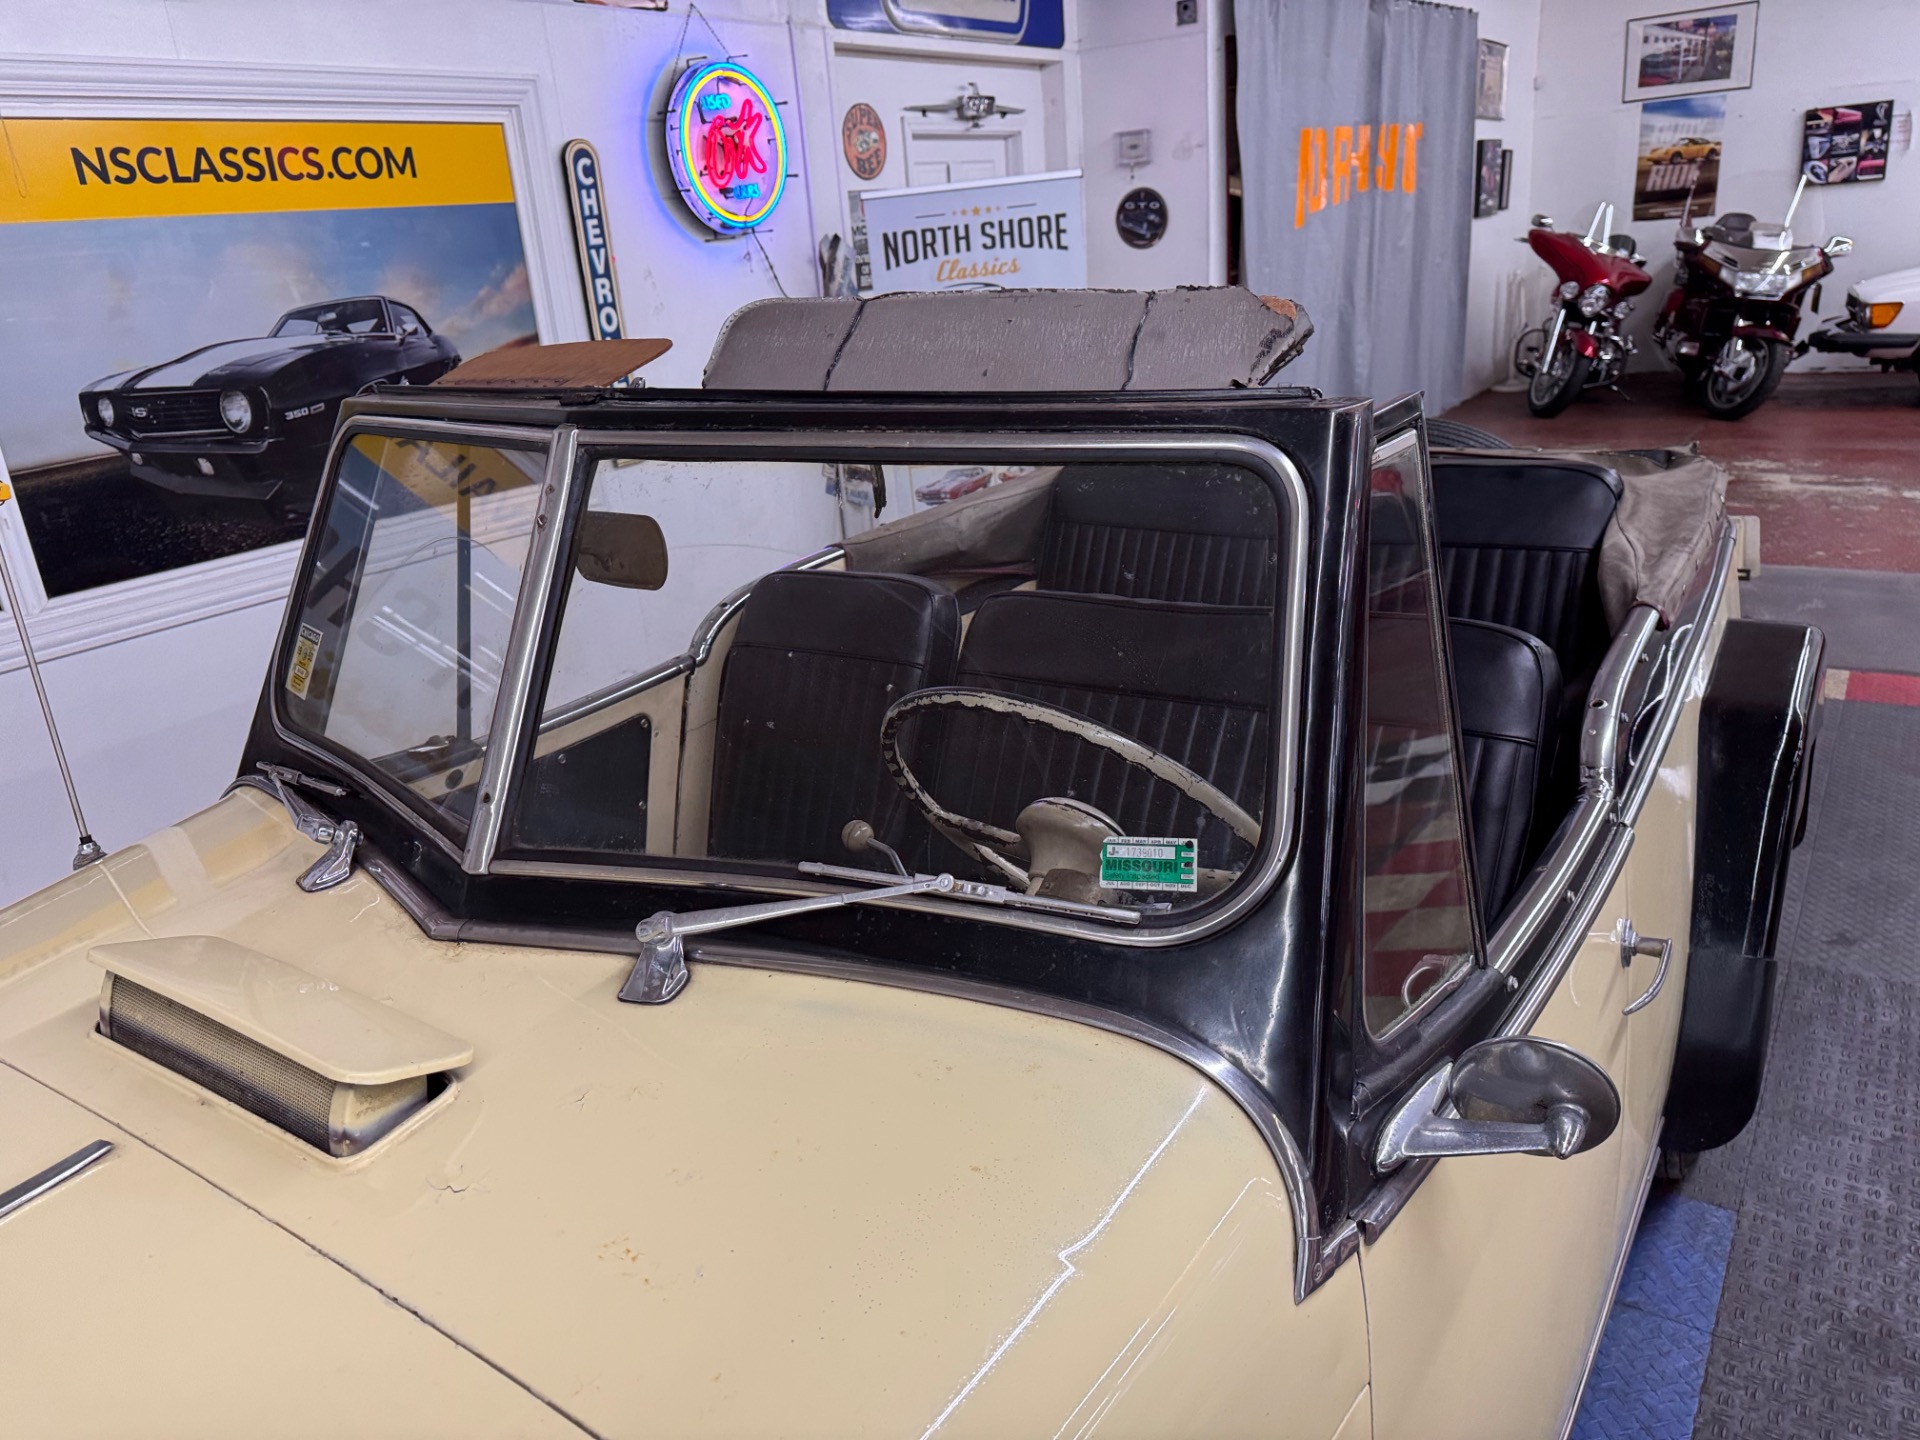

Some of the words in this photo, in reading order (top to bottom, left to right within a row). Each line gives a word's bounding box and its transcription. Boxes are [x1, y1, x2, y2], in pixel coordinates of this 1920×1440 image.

[701, 93, 731, 110] USED
[706, 99, 767, 188] OK
[70, 147, 417, 185] NSCLASSICS.COM
[856, 148, 881, 175] BEE
[1124, 201, 1160, 210] GTO
[882, 224, 971, 271] NORTH
[980, 213, 1069, 251] SHORE
[576, 157, 627, 386] CHEVRO
[936, 256, 1020, 283] Classics
[285, 407, 309, 420] 350
[1105, 859, 1178, 873] MISSOURI
